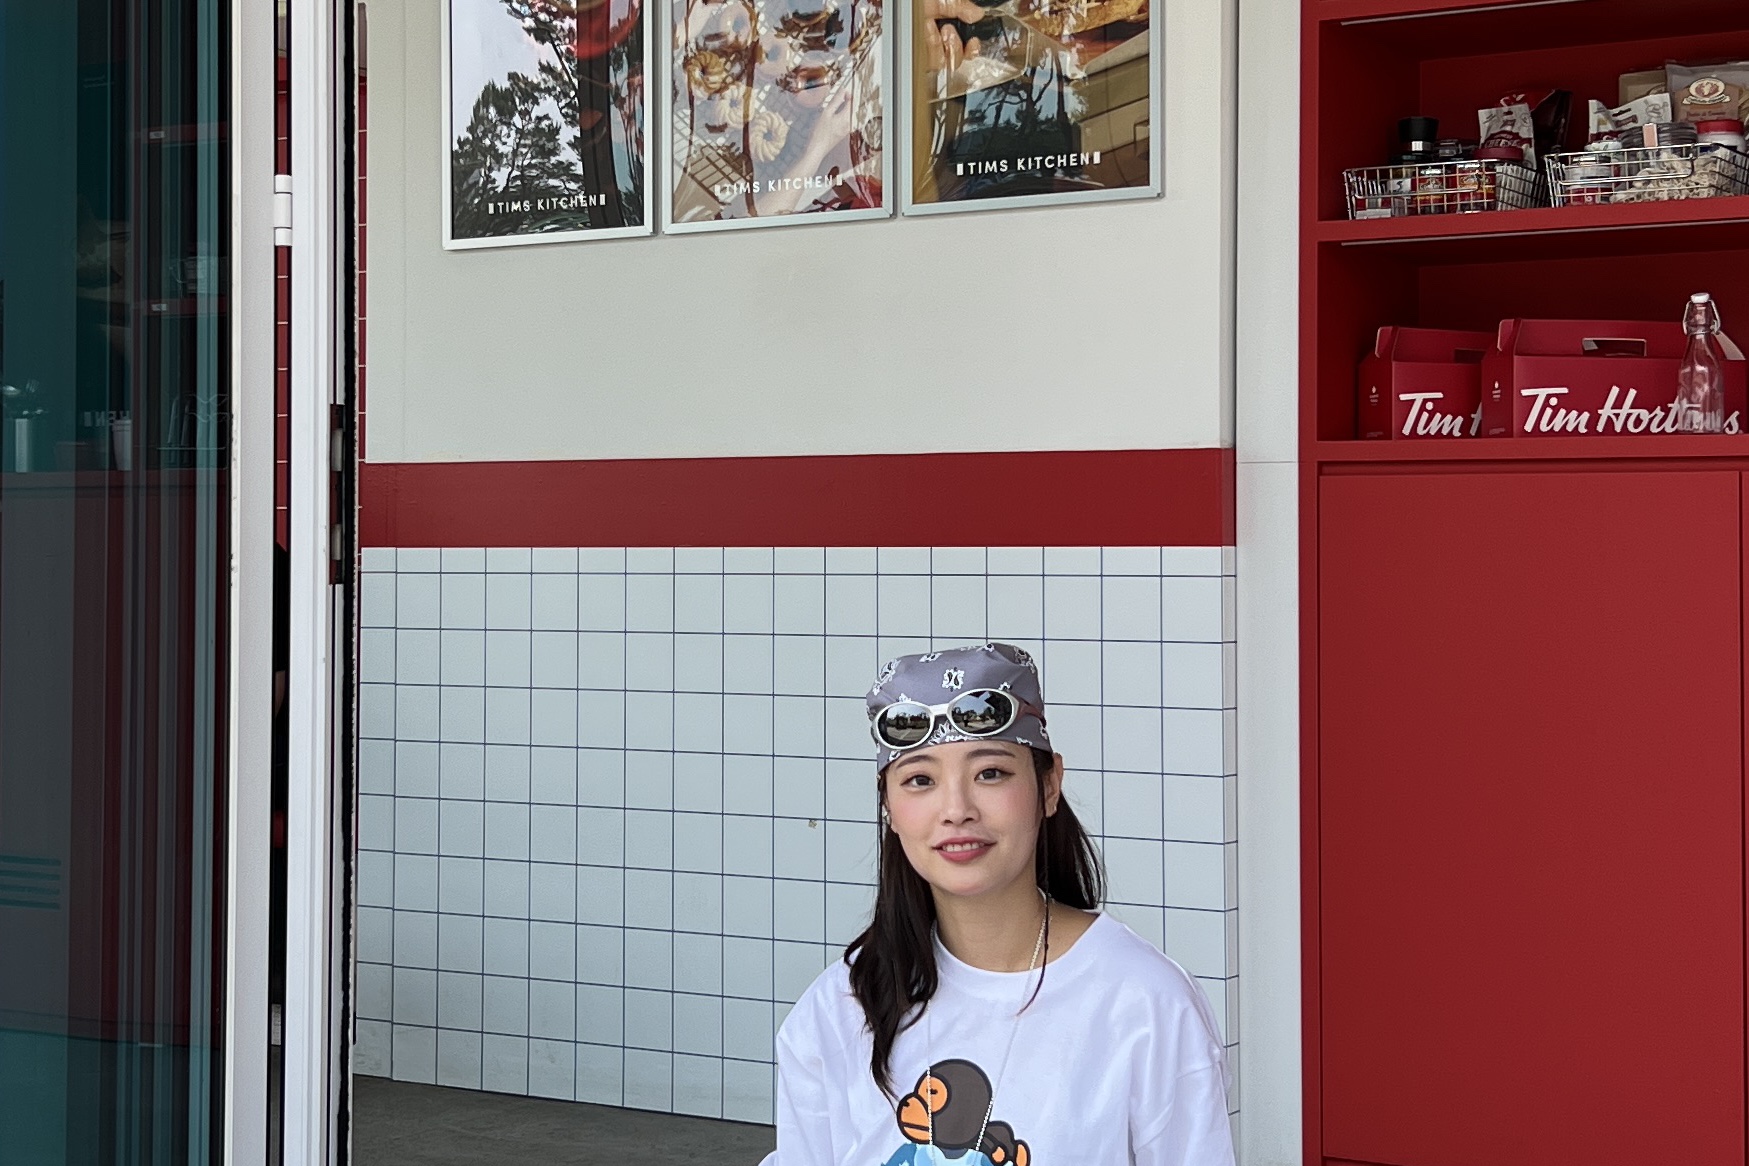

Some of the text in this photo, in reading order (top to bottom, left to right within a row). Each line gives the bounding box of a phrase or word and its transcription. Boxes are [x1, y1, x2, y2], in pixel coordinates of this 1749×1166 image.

[967, 151, 1090, 175] TIMS KITCHEN
[724, 174, 833, 195] TIMS KITCHEN
[497, 194, 597, 214] TIMS KITCHEN
[1399, 392, 1464, 437] Tim
[1520, 387, 1591, 434] Tim
